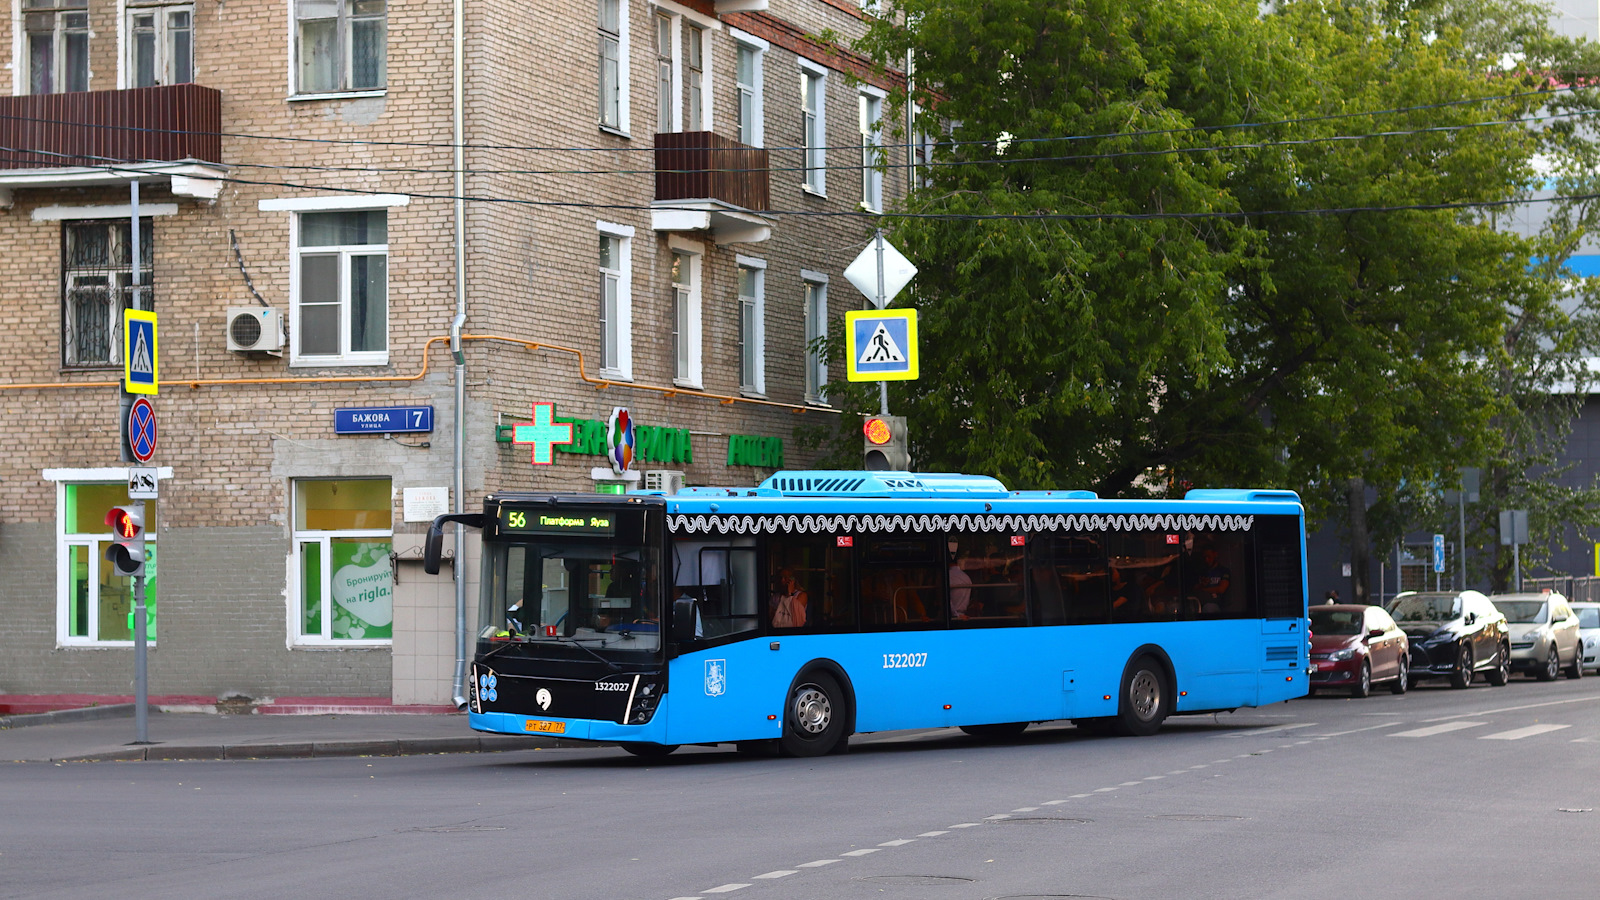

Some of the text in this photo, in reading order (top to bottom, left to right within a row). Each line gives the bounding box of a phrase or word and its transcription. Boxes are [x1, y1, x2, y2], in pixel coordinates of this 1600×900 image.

[352, 413, 390, 423] БАЖОВА
[412, 411, 423, 428] 7
[636, 425, 693, 464] РИГЛА
[727, 434, 784, 468] АПТЕКА
[508, 512, 610, 528] 56 Платформа Яуза
[883, 652, 928, 669] 1322027
[594, 682, 630, 691] 1322027
[539, 722, 552, 731] 327
[556, 722, 563, 730] 77
